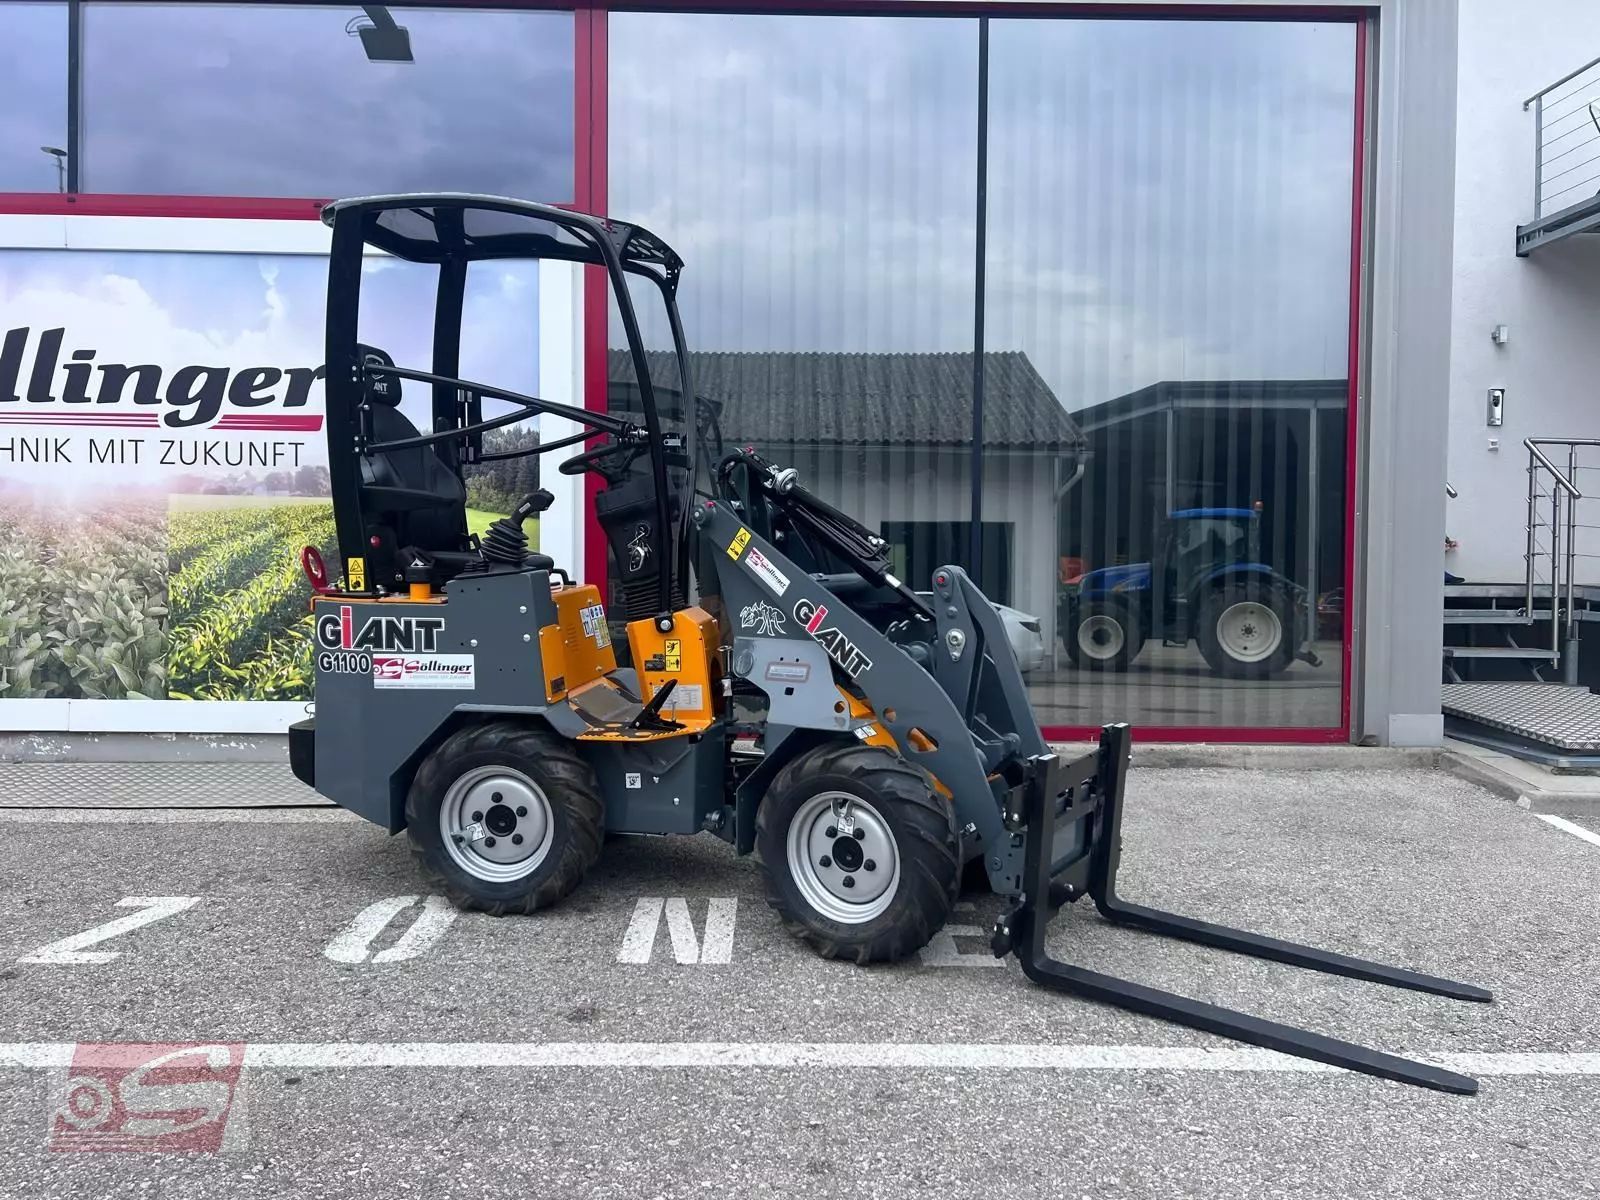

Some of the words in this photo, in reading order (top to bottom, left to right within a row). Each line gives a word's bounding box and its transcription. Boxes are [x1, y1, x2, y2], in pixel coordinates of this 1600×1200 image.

[89, 438, 145, 465] MIT
[159, 439, 305, 467] ZUKUNFT
[319, 652, 372, 674] G1100
